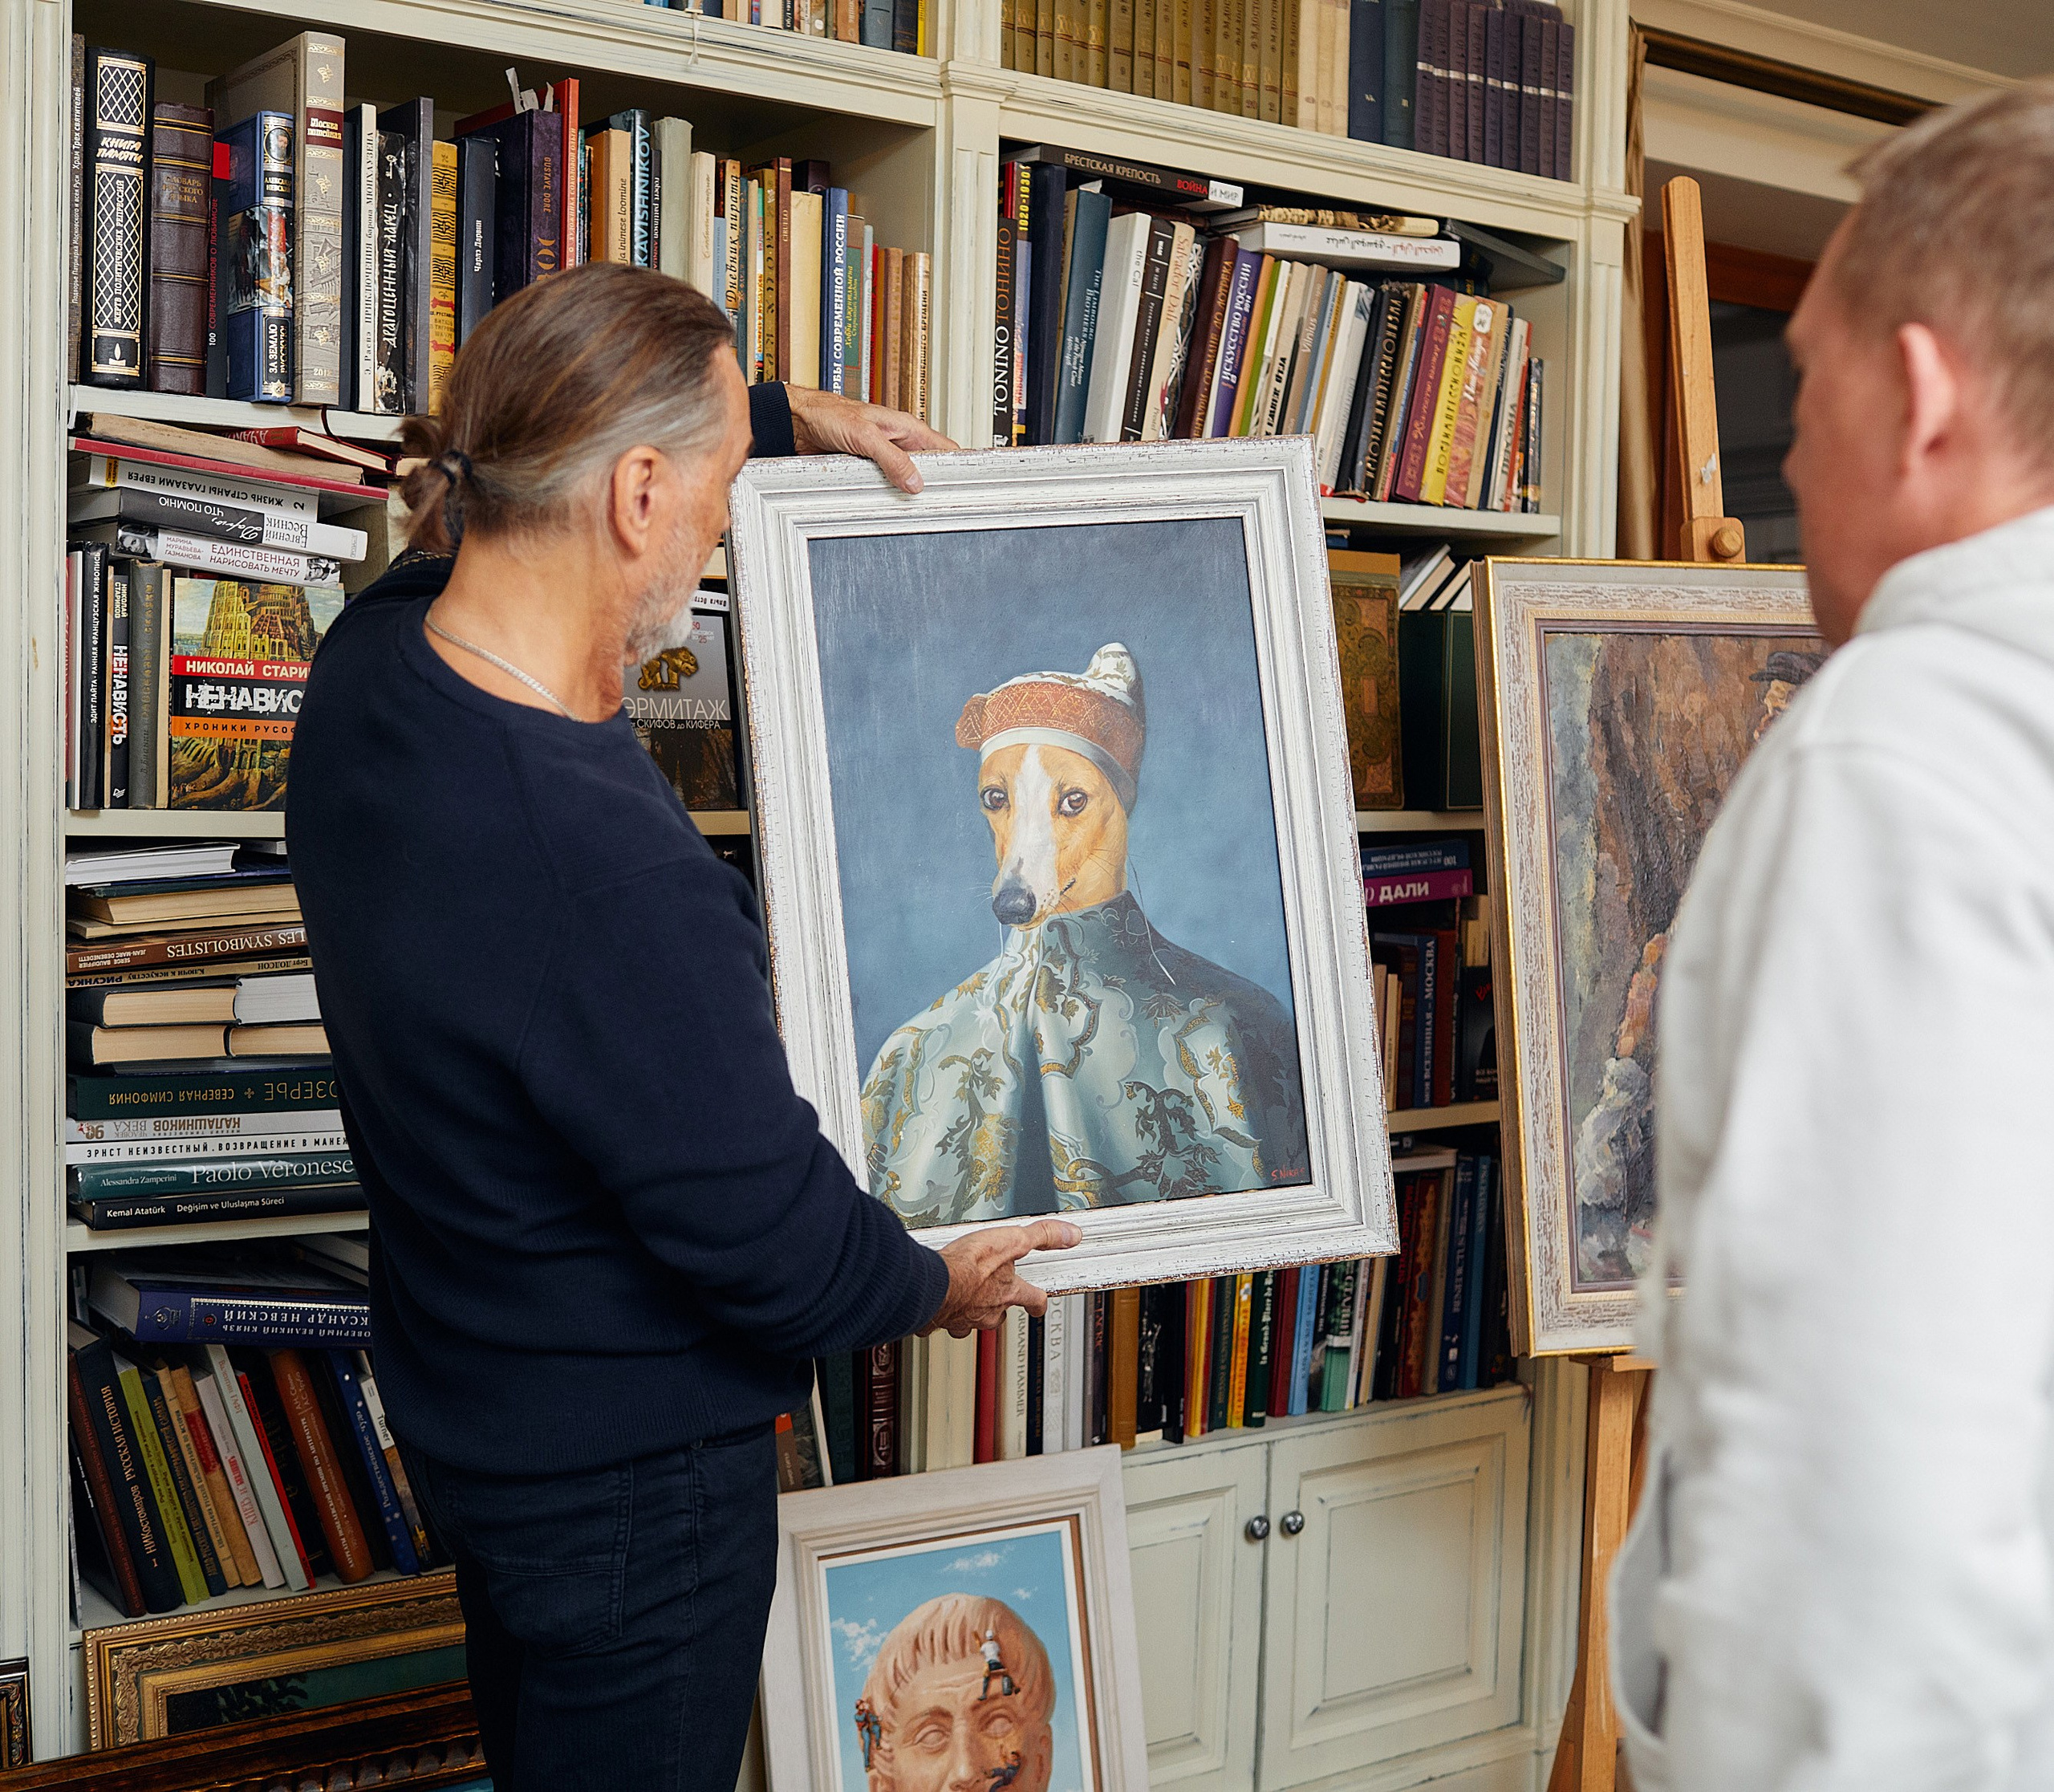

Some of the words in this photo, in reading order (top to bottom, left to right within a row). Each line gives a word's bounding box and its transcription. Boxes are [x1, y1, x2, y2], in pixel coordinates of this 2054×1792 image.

[100, 136, 143, 151] КНИГА
[96, 148, 144, 163] ПАМЯТИ
[364, 132, 375, 205] МЮНХАУЗЕНА
[1064, 153, 1114, 173] БРЕСТСКАЯ
[1116, 166, 1162, 185] КРЕПОСТЬ
[1176, 179, 1208, 195] ВОЙНА
[165, 176, 202, 187] СЛОВАРЬ
[115, 179, 124, 226] РЕПРЕССИЙ
[168, 193, 197, 203] ЯЗЫКА
[542, 193, 550, 213] DORÉ
[635, 125, 649, 266] KAVISHNIKOV
[729, 174, 740, 232] пирата
[365, 209, 374, 238] барона
[384, 203, 396, 242] ЛАРЕЦ
[652, 203, 660, 238] pattinson
[618, 217, 626, 250] inimese
[834, 213, 843, 264] РОССИИ
[114, 229, 123, 295] ПОЛИТИЧЕСКИХ
[617, 251, 627, 261] ja
[1134, 249, 1143, 266] the
[1172, 231, 1189, 291] Salvador
[725, 235, 737, 303] Дневник
[996, 227, 1011, 326] ТОНИНО
[1093, 269, 1102, 287] THE
[363, 242, 373, 323] ПРИКЛЮЧЕНИЯ
[384, 247, 396, 347] ДРАГОЦЕННЫЙ
[113, 297, 121, 323] ЖЕРТВ
[833, 267, 842, 359] СОВРЕМЕННОЙ
[1081, 288, 1093, 340] BROTHERS
[1089, 289, 1100, 341] LIMBOURG
[1221, 311, 1243, 380] ИСКУССТВО
[1233, 262, 1252, 310] РОССИИ
[269, 323, 278, 360] ЗЕМЛЮ
[1301, 316, 1317, 353] Vilnius
[363, 331, 372, 361] Распэ
[269, 360, 277, 373] ЗА
[993, 326, 1009, 416] TONINO
[126, 470, 156, 484] ЕВРЕЯ
[157, 476, 206, 493] ГЛАЗАМИ
[206, 485, 248, 500] СТРАНЫ
[250, 494, 283, 506] ЖИЗНЬ
[156, 495, 202, 513] ПОМНЮ
[203, 504, 225, 516] ЧТО
[293, 501, 306, 511] 2
[263, 516, 310, 534] Весник
[166, 536, 193, 546] МАРИНА
[166, 542, 204, 554] МУРАВЬЕВА-
[263, 529, 309, 547] Евгений
[164, 549, 201, 560] ГАЗМАНОВА
[209, 543, 299, 568] ЕДИНСТВЕННАЯ
[209, 555, 270, 572] НАРИСОВАТЬ
[270, 566, 299, 578] МЕЧТУ
[186, 659, 255, 677] НИКОЛАЙ
[262, 664, 310, 680] СТАРИ
[111, 644, 128, 745] НЕНАВИСТЬ
[185, 681, 305, 714] НЕНАВИС
[622, 697, 727, 721] ЭРМИТАЖ
[185, 722, 247, 733] ХРОНИКИ
[637, 718, 676, 729] СКИФОВ
[685, 719, 721, 729] КИФЕРА
[1379, 882, 1429, 903] ДАЛИ
[166, 933, 273, 957] SYMBOLISTES
[278, 929, 306, 944] LES
[78, 958, 112, 969] BAUDIFFIER
[112, 956, 131, 964] SERGE
[115, 948, 147, 958] JEAN-MARC
[291, 957, 309, 966] Берт
[67, 974, 123, 986] РИСУНКА
[126, 969, 168, 981] искусству
[177, 966, 205, 976] Ключи
[1424, 940, 1435, 1000] МОСКВА
[108, 1089, 173, 1106] СИМФОНИЯ
[178, 1087, 235, 1103] СЕВЕРНАЯ
[112, 1119, 147, 1131] ВЕКА
[152, 1117, 240, 1132] КАЛАШНИКОВ
[86, 1148, 122, 1158] ЭРНСТ
[217, 1140, 297, 1152] ВОЗВРАЩЕНИЕ
[100, 1176, 139, 1188] Alessandra
[139, 1172, 177, 1185] Zamperini
[190, 1160, 252, 1185] Paolo
[257, 1154, 354, 1180] Veronese
[106, 1208, 133, 1217] Kemal
[134, 1205, 165, 1216] Atatürk
[176, 1202, 209, 1213] Değişim
[220, 1198, 260, 1210] Uluslaşma
[261, 1196, 286, 1206] Süreci
[223, 1310, 300, 1324] НЕВСКИЙ
[306, 1313, 368, 1325] КСАНДР
[221, 1324, 258, 1332] КНЯЗЬ
[262, 1326, 313, 1335] ВЕЛИКИЙ
[318, 1328, 370, 1338] ОВЕРНЫЙ
[1016, 1363, 1024, 1413] HAMMER
[99, 1384, 123, 1434] ИСТОРИЯ
[355, 1408, 369, 1432] чудо
[376, 1412, 391, 1442] Turner
[114, 1434, 136, 1481] РУССКАЯ
[362, 1433, 392, 1507] Рождественское
[238, 1495, 258, 1526] КИЕВ
